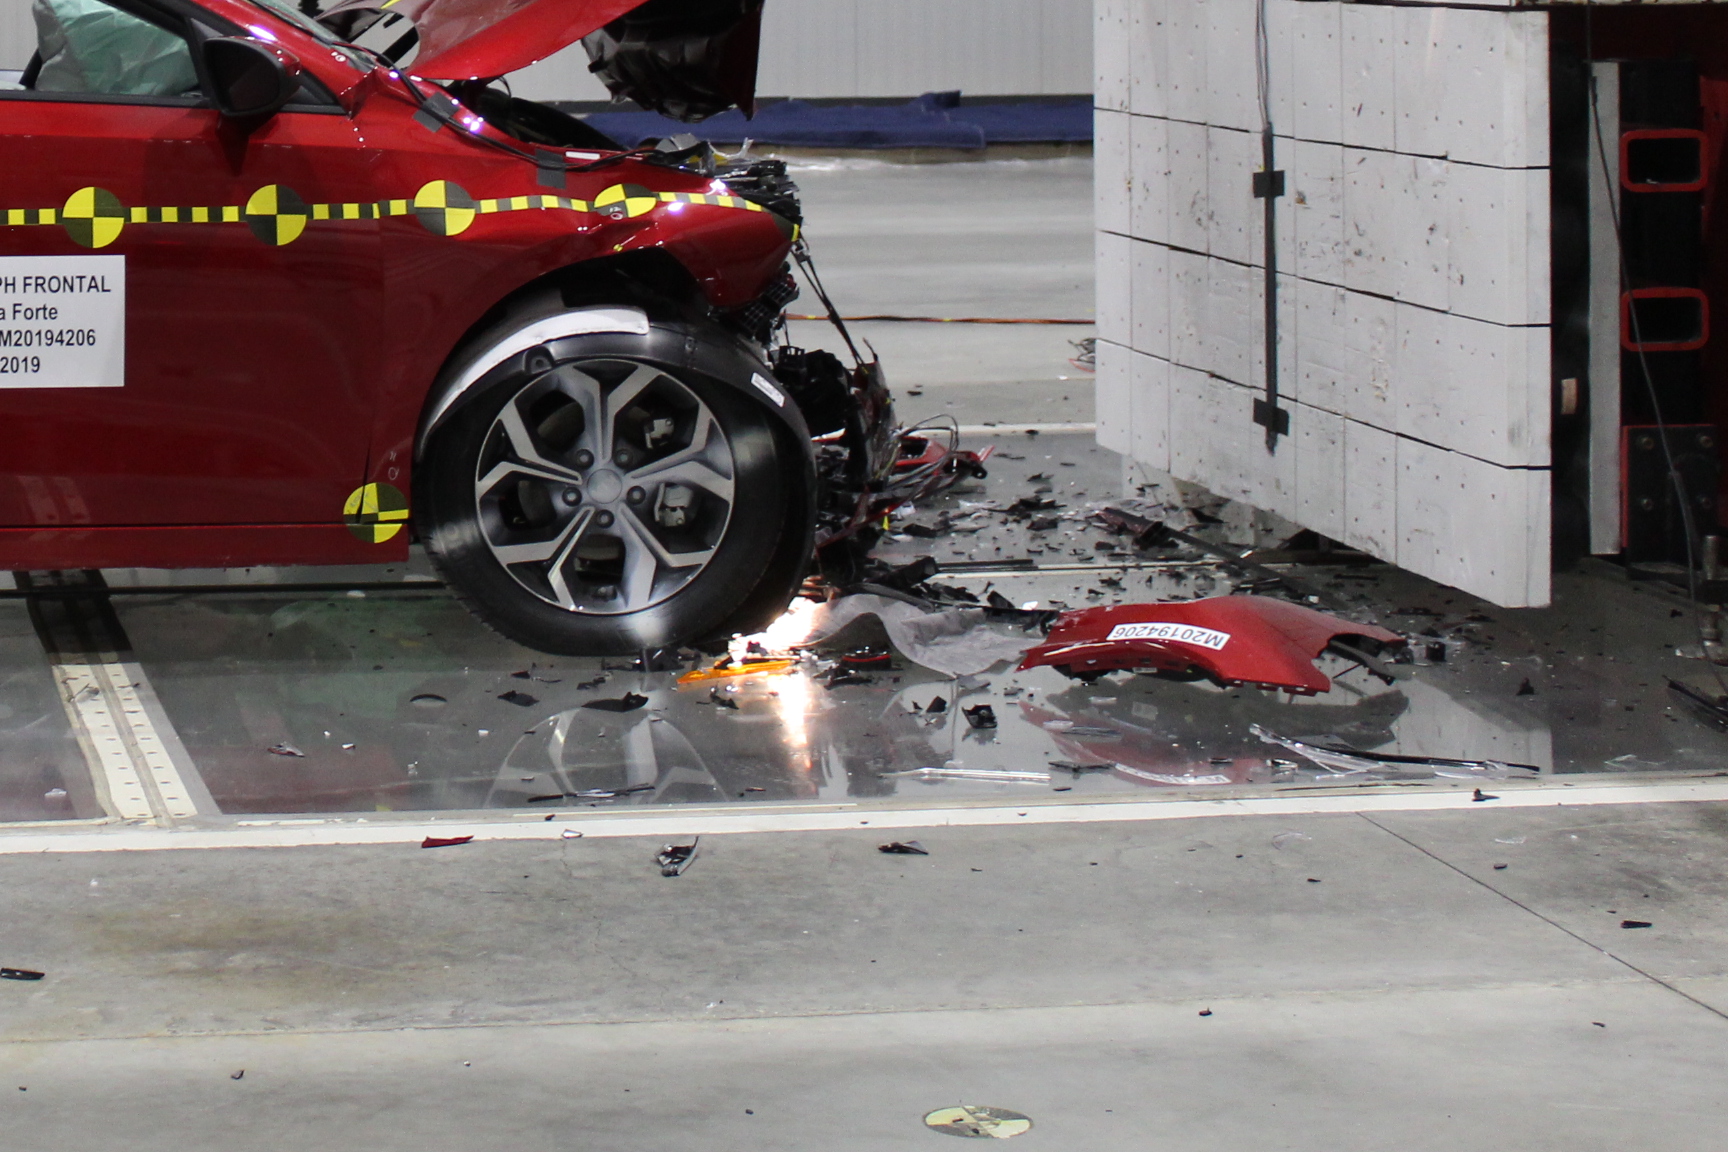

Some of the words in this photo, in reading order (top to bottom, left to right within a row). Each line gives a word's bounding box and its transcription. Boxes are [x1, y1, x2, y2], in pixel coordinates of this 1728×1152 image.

[23, 275, 111, 294] FRONTAL
[12, 303, 58, 320] Forte
[1113, 626, 1225, 647] M20194206
